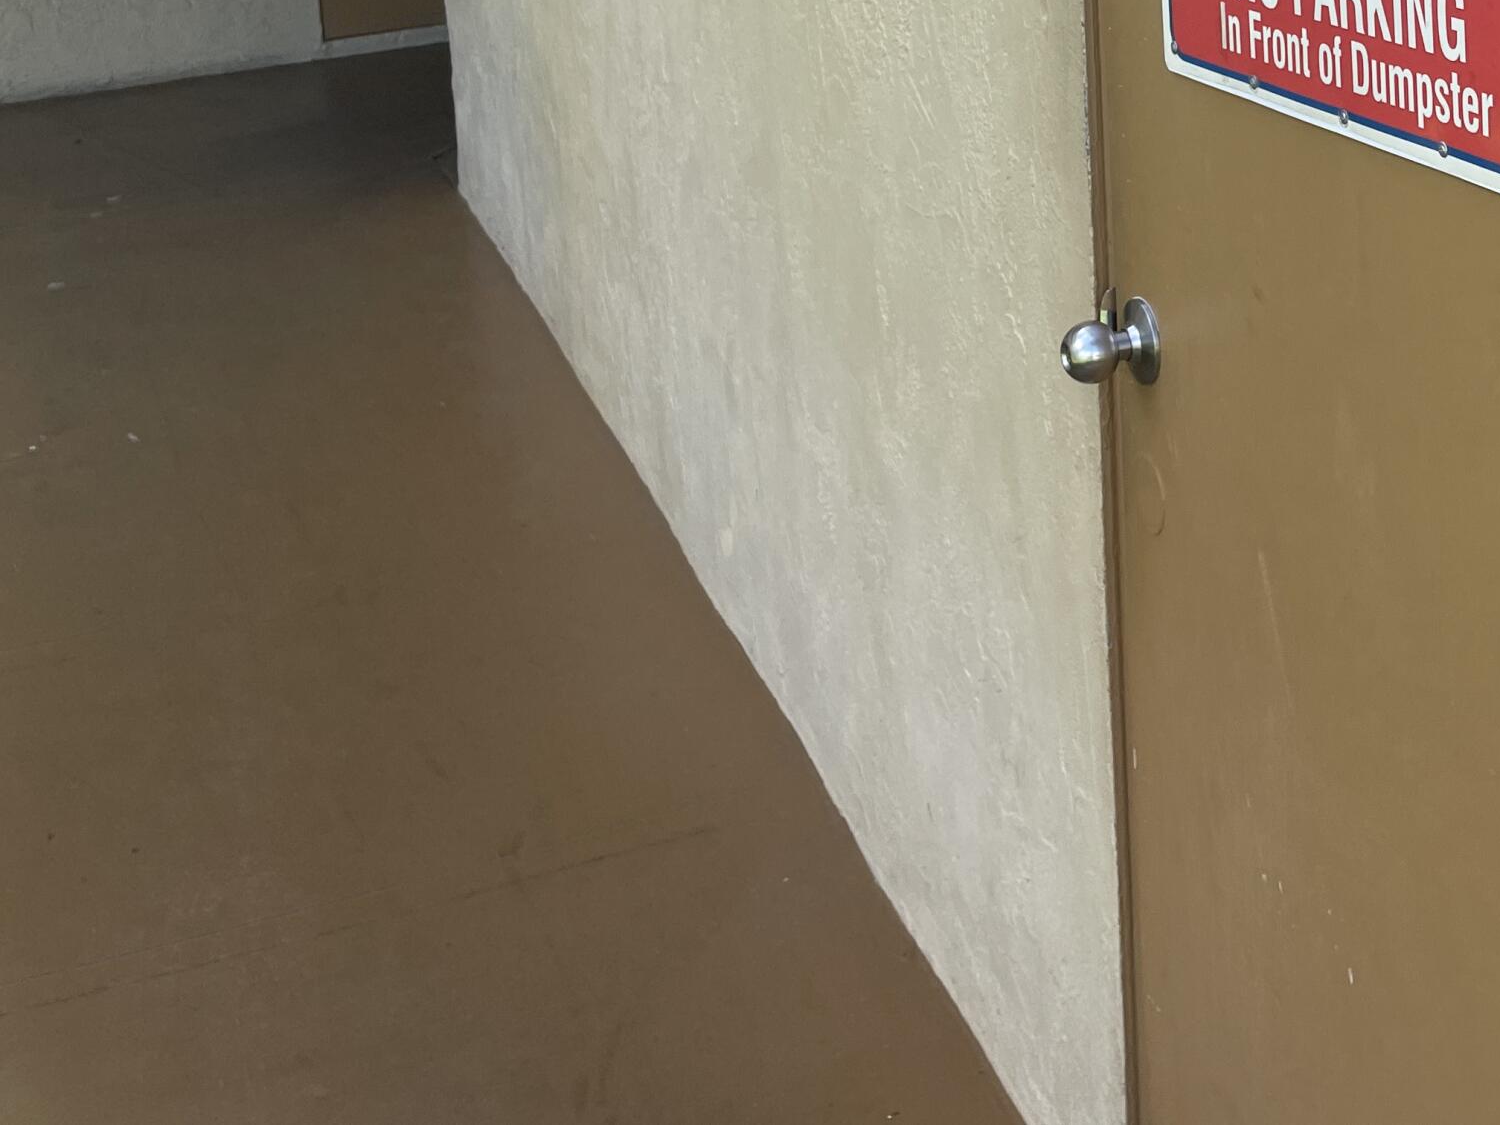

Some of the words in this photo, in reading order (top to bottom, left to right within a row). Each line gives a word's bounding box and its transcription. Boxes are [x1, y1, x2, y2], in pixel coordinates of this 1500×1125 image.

[1220, 1, 1241, 54] In
[1248, 9, 1310, 78] Front
[1318, 35, 1342, 88] of
[1350, 40, 1493, 138] Dumpster
